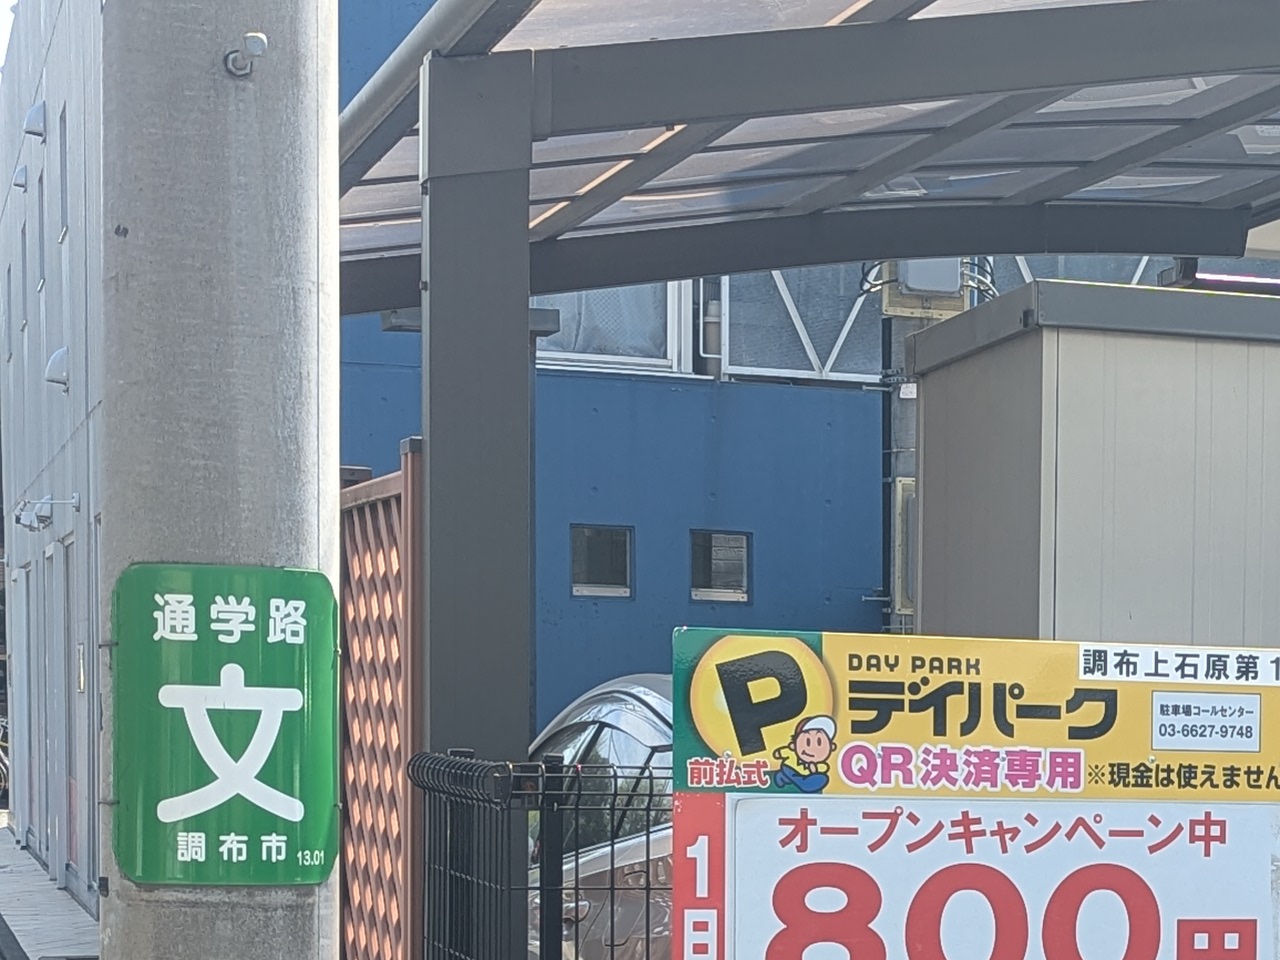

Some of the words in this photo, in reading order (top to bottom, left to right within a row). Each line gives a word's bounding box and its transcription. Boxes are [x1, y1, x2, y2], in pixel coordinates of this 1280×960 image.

[153, 593, 307, 644] 通学路
[848, 653, 899, 673] DAY
[911, 656, 981, 676] PARK
[848, 676, 1118, 740] デイパーク
[1159, 703, 1254, 718] 駐車場コールセンター
[157, 663, 305, 823] 文
[1158, 724, 1253, 740] 03-6627-9748
[687, 759, 769, 786] 前払式
[841, 745, 1082, 790] QR決済専用
[778, 806, 1227, 857] オープンキャンペーン中
[177, 832, 287, 863] 調布市
[297, 850, 325, 866] 13.01
